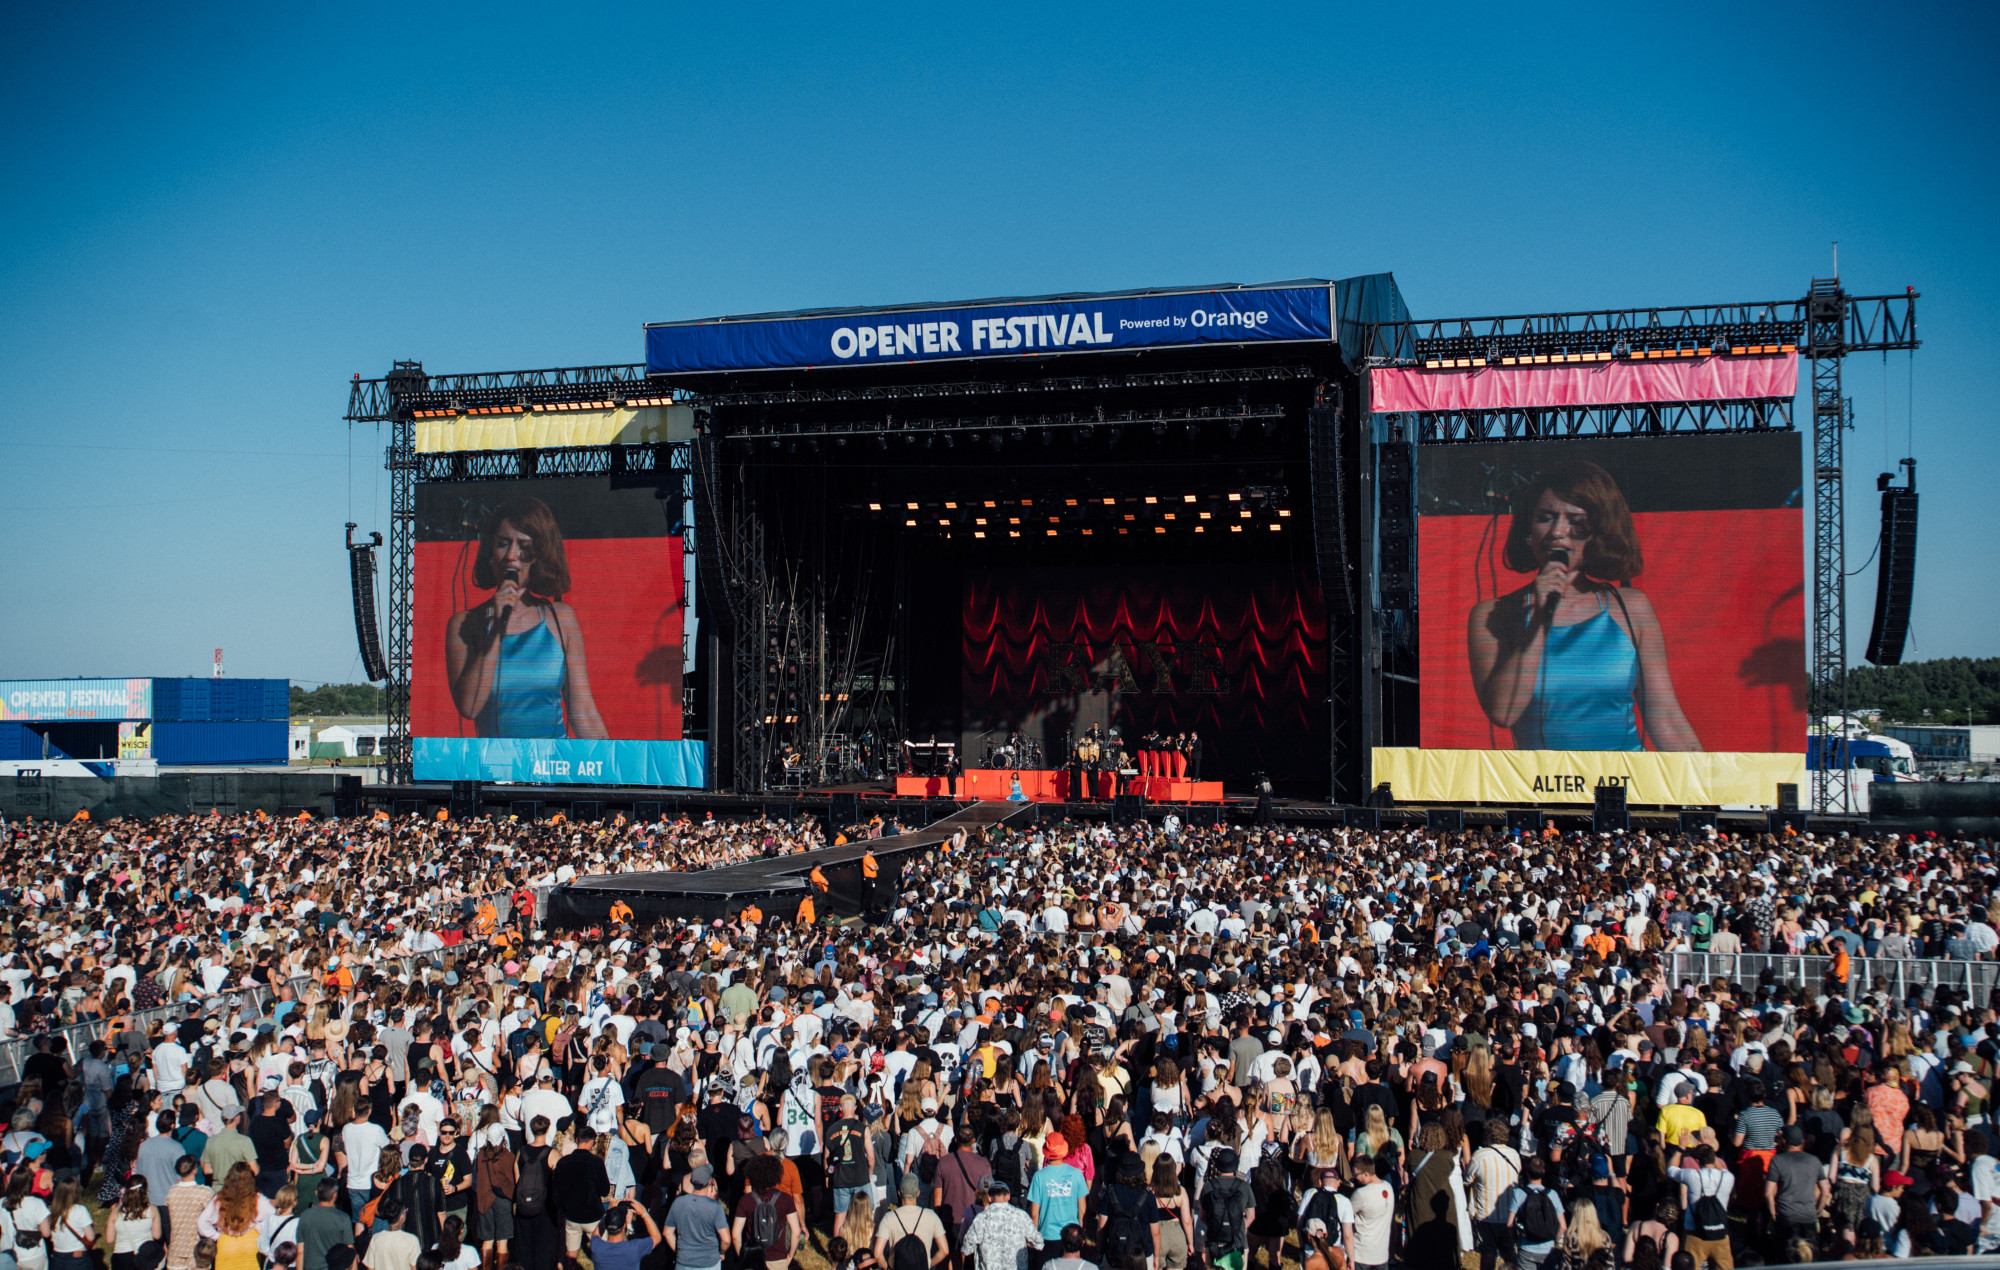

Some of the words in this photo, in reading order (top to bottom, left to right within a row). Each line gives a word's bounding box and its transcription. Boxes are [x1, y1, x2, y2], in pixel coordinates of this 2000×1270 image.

[830, 321, 961, 359] OPEN'ER
[972, 311, 1113, 351] FESTIVAL
[1120, 316, 1170, 330] Powered
[1173, 316, 1187, 329] by
[1191, 309, 1269, 329] Orange
[1043, 642, 1231, 694] RAYE
[11, 691, 66, 707] OPEN'ER
[70, 689, 130, 706] FESTIVAL
[66, 707, 97, 718] Orange
[533, 760, 571, 776] ALTER
[578, 761, 603, 776] ART
[1533, 775, 1586, 793] ALTER
[787, 1109, 809, 1126] 34
